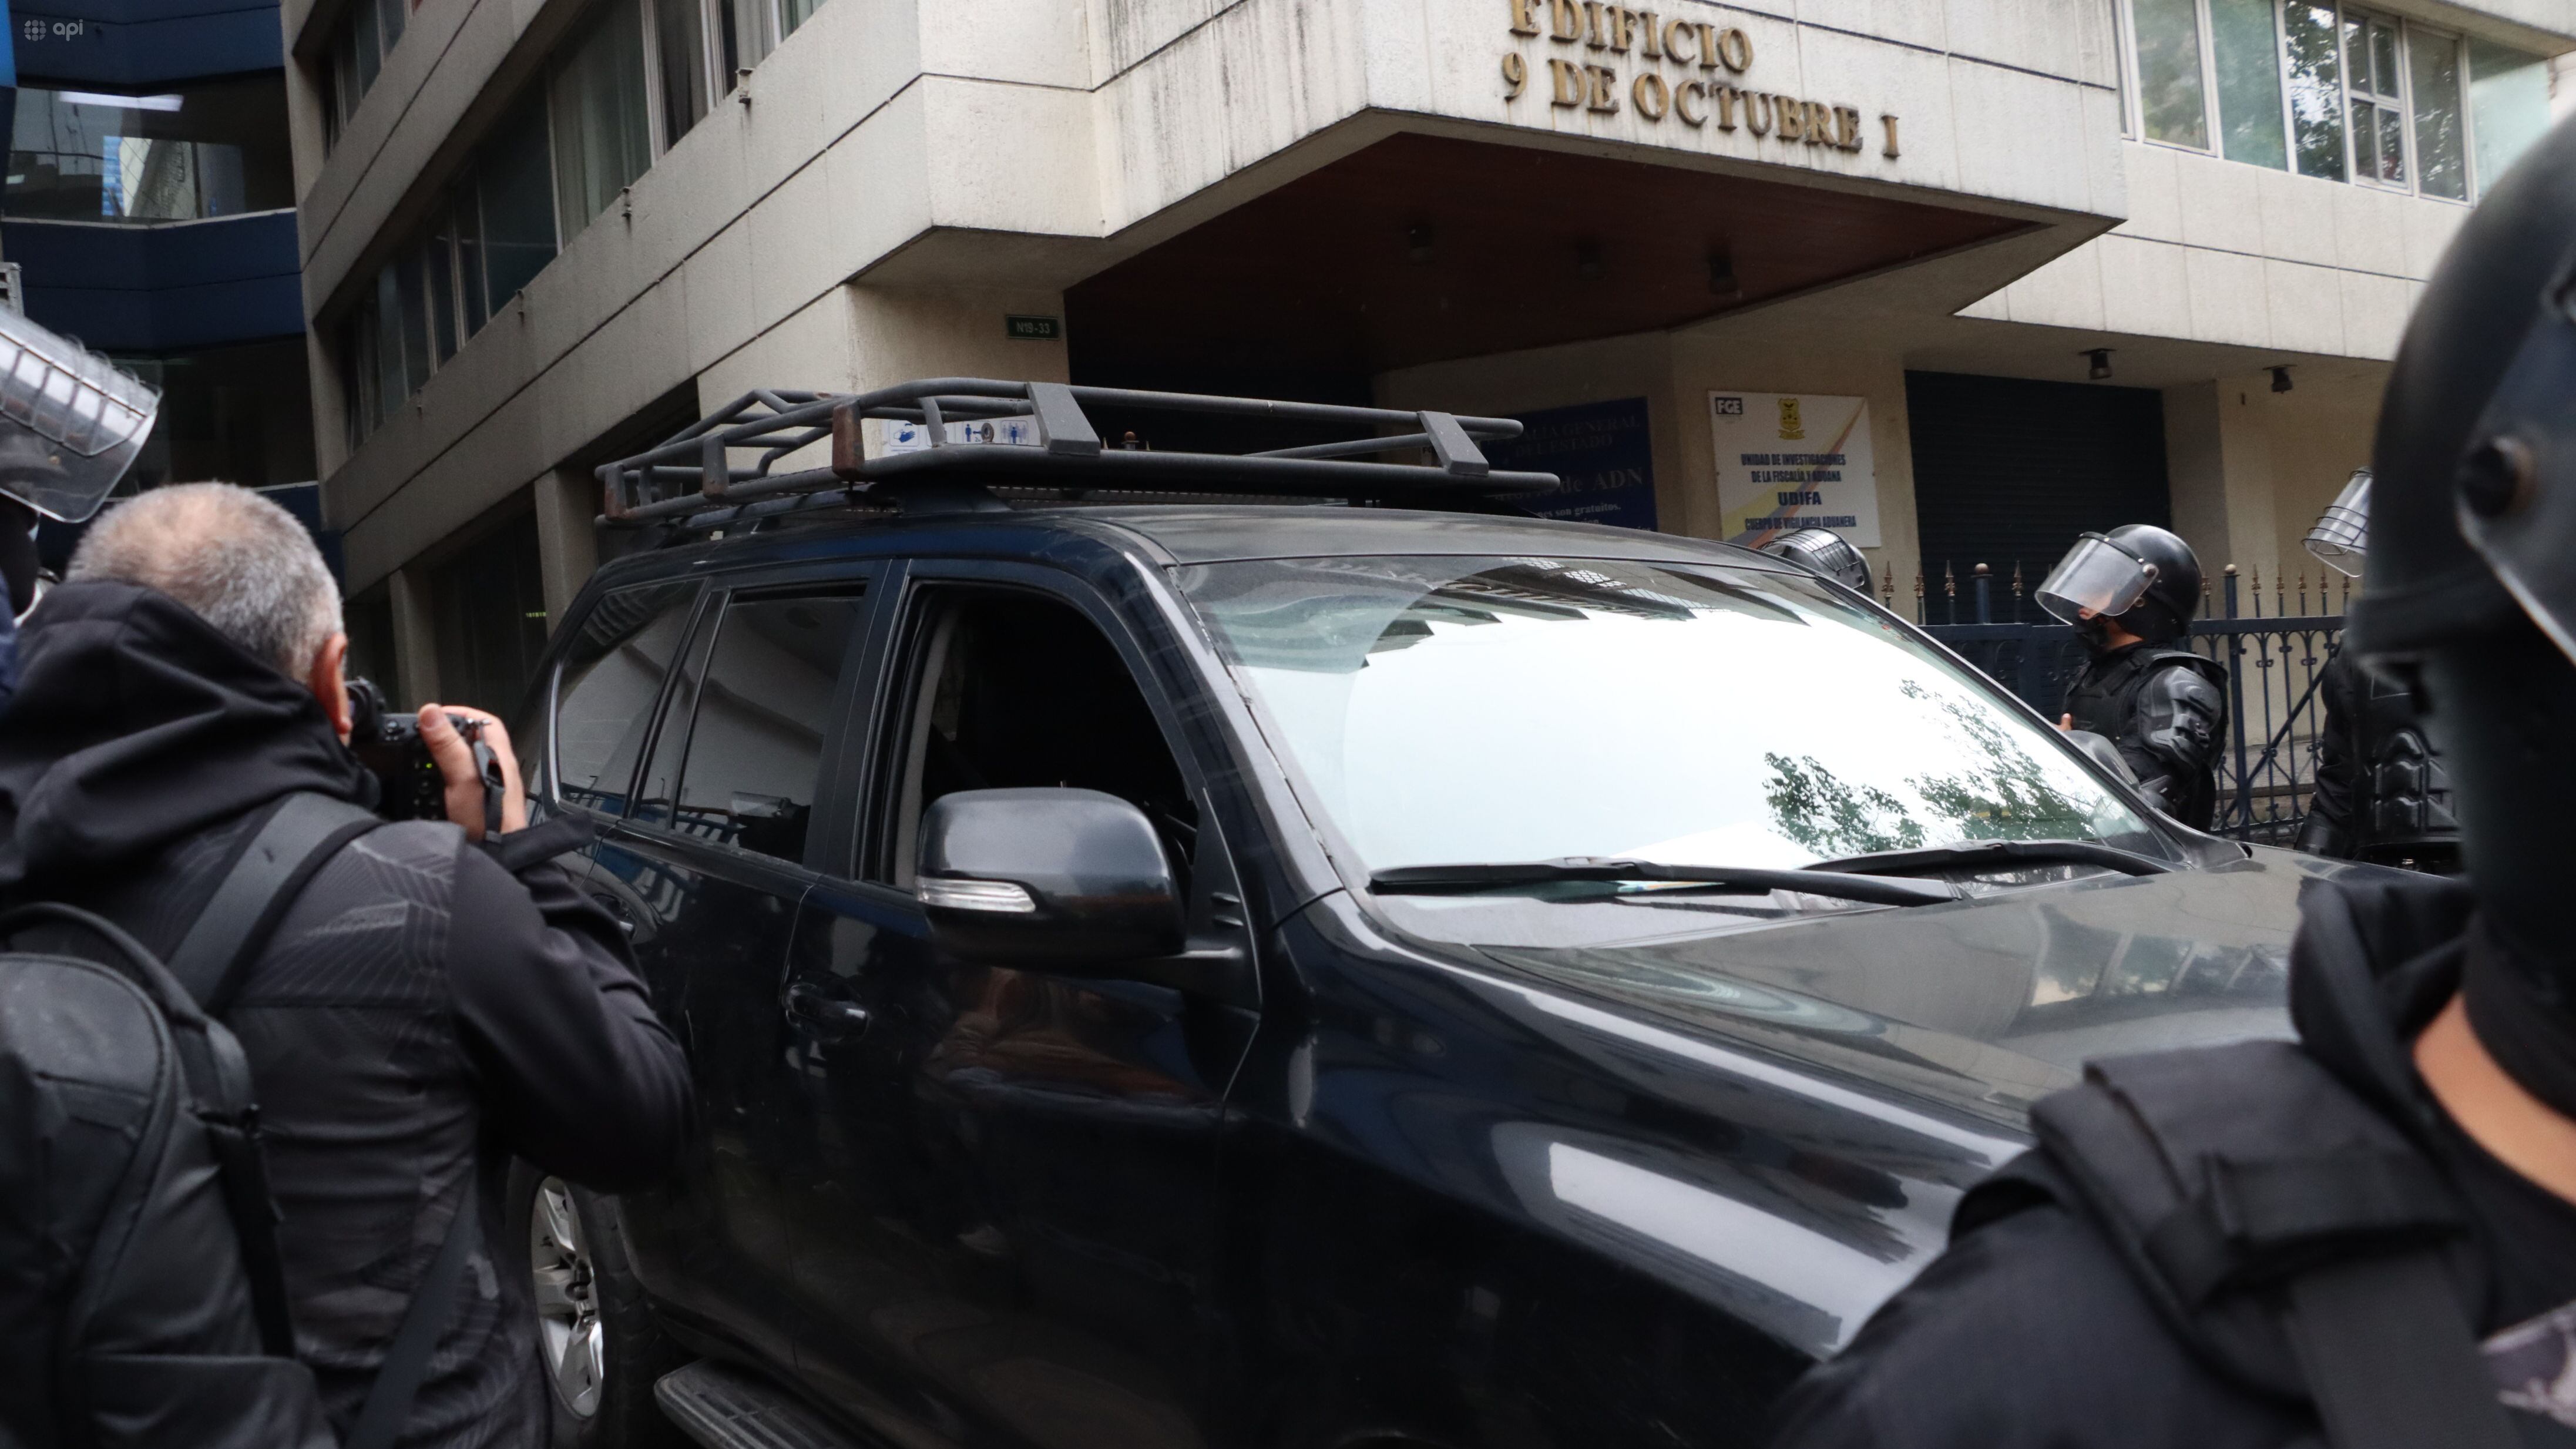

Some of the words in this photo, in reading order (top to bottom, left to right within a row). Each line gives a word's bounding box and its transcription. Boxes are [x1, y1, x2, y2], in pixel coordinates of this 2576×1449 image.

[1509, 0, 1754, 72] EDIFICIO
[1502, 52, 1527, 100] 9
[1549, 58, 1620, 114] DE
[1633, 72, 1863, 152] OCTUBRE
[1881, 115, 1900, 159] I
[1016, 321, 1050, 334] N19-33
[1717, 399, 1741, 414] FGE
[1562, 414, 1640, 434] GENERAL
[1516, 442, 1543, 458] DEL
[1550, 434, 1614, 452] ESTADO
[1741, 454, 1769, 465] UNIDAD
[1772, 454, 1781, 465] DE
[1782, 454, 1846, 465] INVESTIGACIONES
[1560, 474, 1584, 494] de
[1591, 467, 1644, 489] ADN
[1751, 471, 1762, 482] DE
[1762, 471, 1772, 482] LA
[1806, 471, 1812, 482] Y
[1812, 471, 1842, 482] ADUANA
[1554, 508, 1572, 516] son
[1573, 501, 1621, 516] gratuitos.
[1773, 518, 1782, 529] DE
